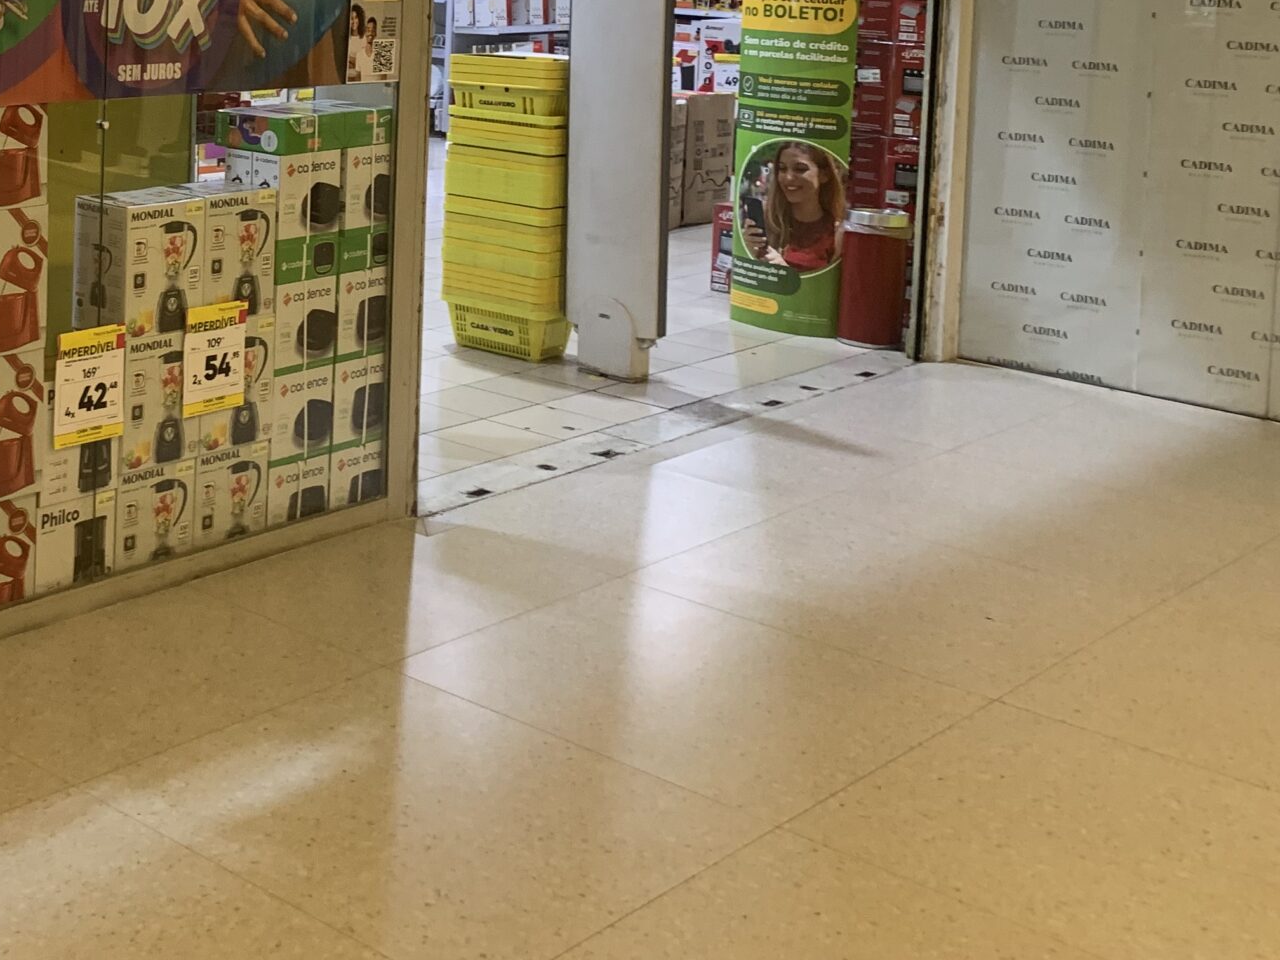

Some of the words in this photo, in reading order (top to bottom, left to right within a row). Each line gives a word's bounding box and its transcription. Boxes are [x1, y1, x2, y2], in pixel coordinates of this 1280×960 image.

[83, 0, 99, 13] ATÉ
[745, 7, 759, 17] no
[763, 4, 844, 22] BOLETO!
[1038, 20, 1083, 31] CADIMA
[761, 38, 790, 47] cartão
[793, 40, 806, 48] de
[809, 41, 849, 51] crédito
[1226, 41, 1279, 52] CADIMA
[796, 53, 848, 62] facilitadas
[1002, 56, 1047, 67] CADIMA
[118, 64, 141, 81] SEM
[143, 62, 182, 80] JUROS
[1072, 60, 1118, 72] CADIMA
[1185, 79, 1237, 91] CADIMA
[1035, 96, 1080, 108] CADIMA
[1222, 122, 1275, 135] CADIMA
[998, 132, 1044, 144] CADIMA
[1068, 138, 1114, 151] CADIMA
[1181, 159, 1233, 173] CADIMA
[1031, 172, 1077, 185] CADIMA
[210, 196, 248, 209] MONDIAL
[131, 209, 175, 222] MONDIAL
[994, 207, 1040, 220] CADIMA
[1217, 203, 1270, 218] CADIMA
[1064, 215, 1110, 229] CADIMA
[1176, 240, 1228, 254] CADIMA
[1027, 248, 1072, 262] CADIMA
[991, 282, 1037, 295] CADIMA
[1212, 285, 1265, 300] CADIMA
[1060, 292, 1106, 306] CADIMA
[190, 316, 237, 333] MPERDÍVEL
[1171, 319, 1223, 335] CADIMA
[1023, 324, 1068, 339] CADIMA
[60, 341, 115, 360] IMPERDÍVEL
[130, 340, 174, 353] MONDIAL
[1207, 365, 1260, 382] CADIMA
[64, 407, 76, 418] 4x
[200, 449, 240, 466] MONDIAL
[122, 468, 164, 486] MONDIAL
[41, 510, 80, 529] Philco
